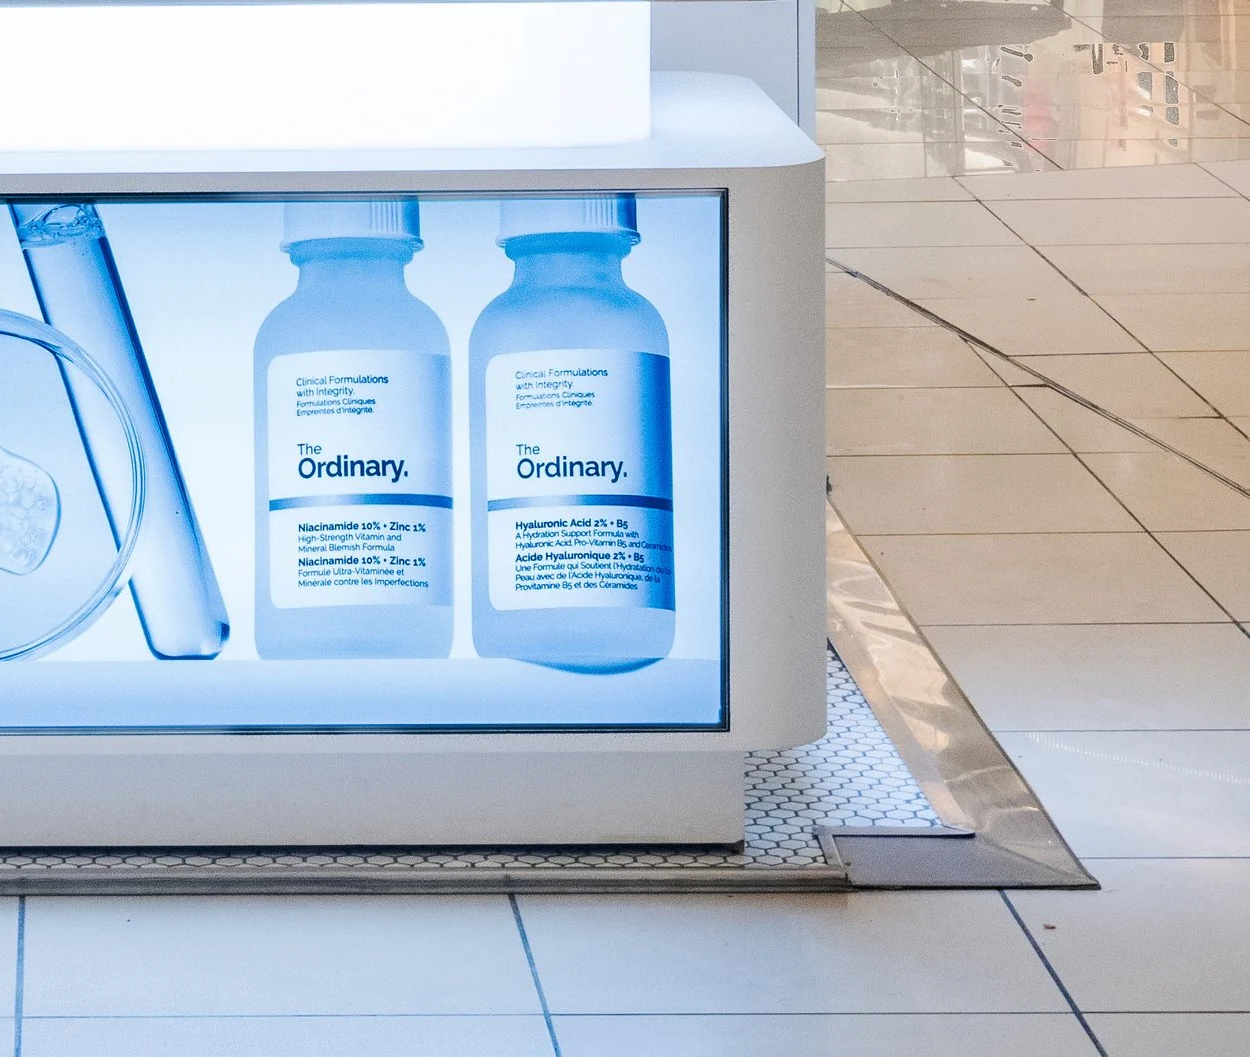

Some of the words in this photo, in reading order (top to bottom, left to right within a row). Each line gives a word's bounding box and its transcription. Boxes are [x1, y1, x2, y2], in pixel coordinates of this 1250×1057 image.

[515, 369, 546, 380] Clinical
[548, 368, 609, 377] Formulations
[296, 375, 327, 387] Clinical
[328, 375, 389, 385] Formulations
[515, 381, 533, 390] with
[296, 388, 314, 397] with
[316, 386, 355, 397] Integrity.
[515, 392, 560, 401] Formulations
[561, 391, 595, 400] Cliniques
[296, 399, 341, 408] Formulations
[342, 398, 376, 407] Cliniques
[516, 401, 554, 410] Empreintes
[296, 407, 335, 417] Empreintes
[297, 443, 322, 455] The
[516, 443, 540, 455] The
[298, 455, 408, 483] Ordinary.
[517, 456, 627, 483] Ordinary.
[298, 521, 359, 533] Niacinamide
[361, 521, 381, 531] 10%
[389, 521, 411, 532] Zinc
[412, 523, 426, 533] 1%
[515, 518, 568, 531] Hyaluronic
[570, 518, 592, 528] Acid
[594, 518, 607, 528] 2%
[616, 519, 628, 530] B5
[298, 533, 354, 544] High-Strength
[355, 533, 385, 542] Vitamin
[386, 533, 402, 542] and
[522, 530, 559, 540] Hydration
[561, 529, 592, 539] Support
[593, 530, 624, 538] Formula
[625, 530, 639, 539] with
[298, 544, 327, 553] Mineral
[329, 543, 361, 552] Blemish
[362, 543, 395, 552] Formula
[515, 540, 553, 550] Hyaluronic
[574, 539, 616, 547] Pro-Vitamin
[628, 540, 641, 548] and
[298, 555, 359, 567] Niacinamide
[361, 555, 381, 565] 10%
[389, 556, 411, 566] Zinc
[412, 557, 426, 567] 1%
[515, 553, 543, 563] Acide
[545, 550, 611, 563] Hyaluronique
[612, 551, 626, 561] 2%
[633, 552, 645, 563] B5
[298, 569, 331, 578] Formule
[333, 567, 395, 576] Ultra-Vitaminée
[396, 568, 404, 576] et
[515, 564, 532, 572] Une
[533, 563, 566, 571] Formule
[567, 562, 579, 572] qui
[580, 562, 612, 570] Soutient
[655, 566, 664, 574] de
[298, 578, 332, 587] Minérale
[334, 578, 360, 586] contre
[361, 577, 373, 586] les
[515, 573, 535, 582] Peau
[536, 573, 555, 581] avec
[556, 572, 567, 580] de
[568, 571, 593, 579] l'Acide
[644, 574, 654, 582] de
[654, 574, 661, 583] la
[515, 582, 561, 591] Provitamine
[562, 582, 573, 590] B5
[574, 581, 582, 589] et
[583, 581, 597, 589] des
[599, 580, 638, 591] Céramides
